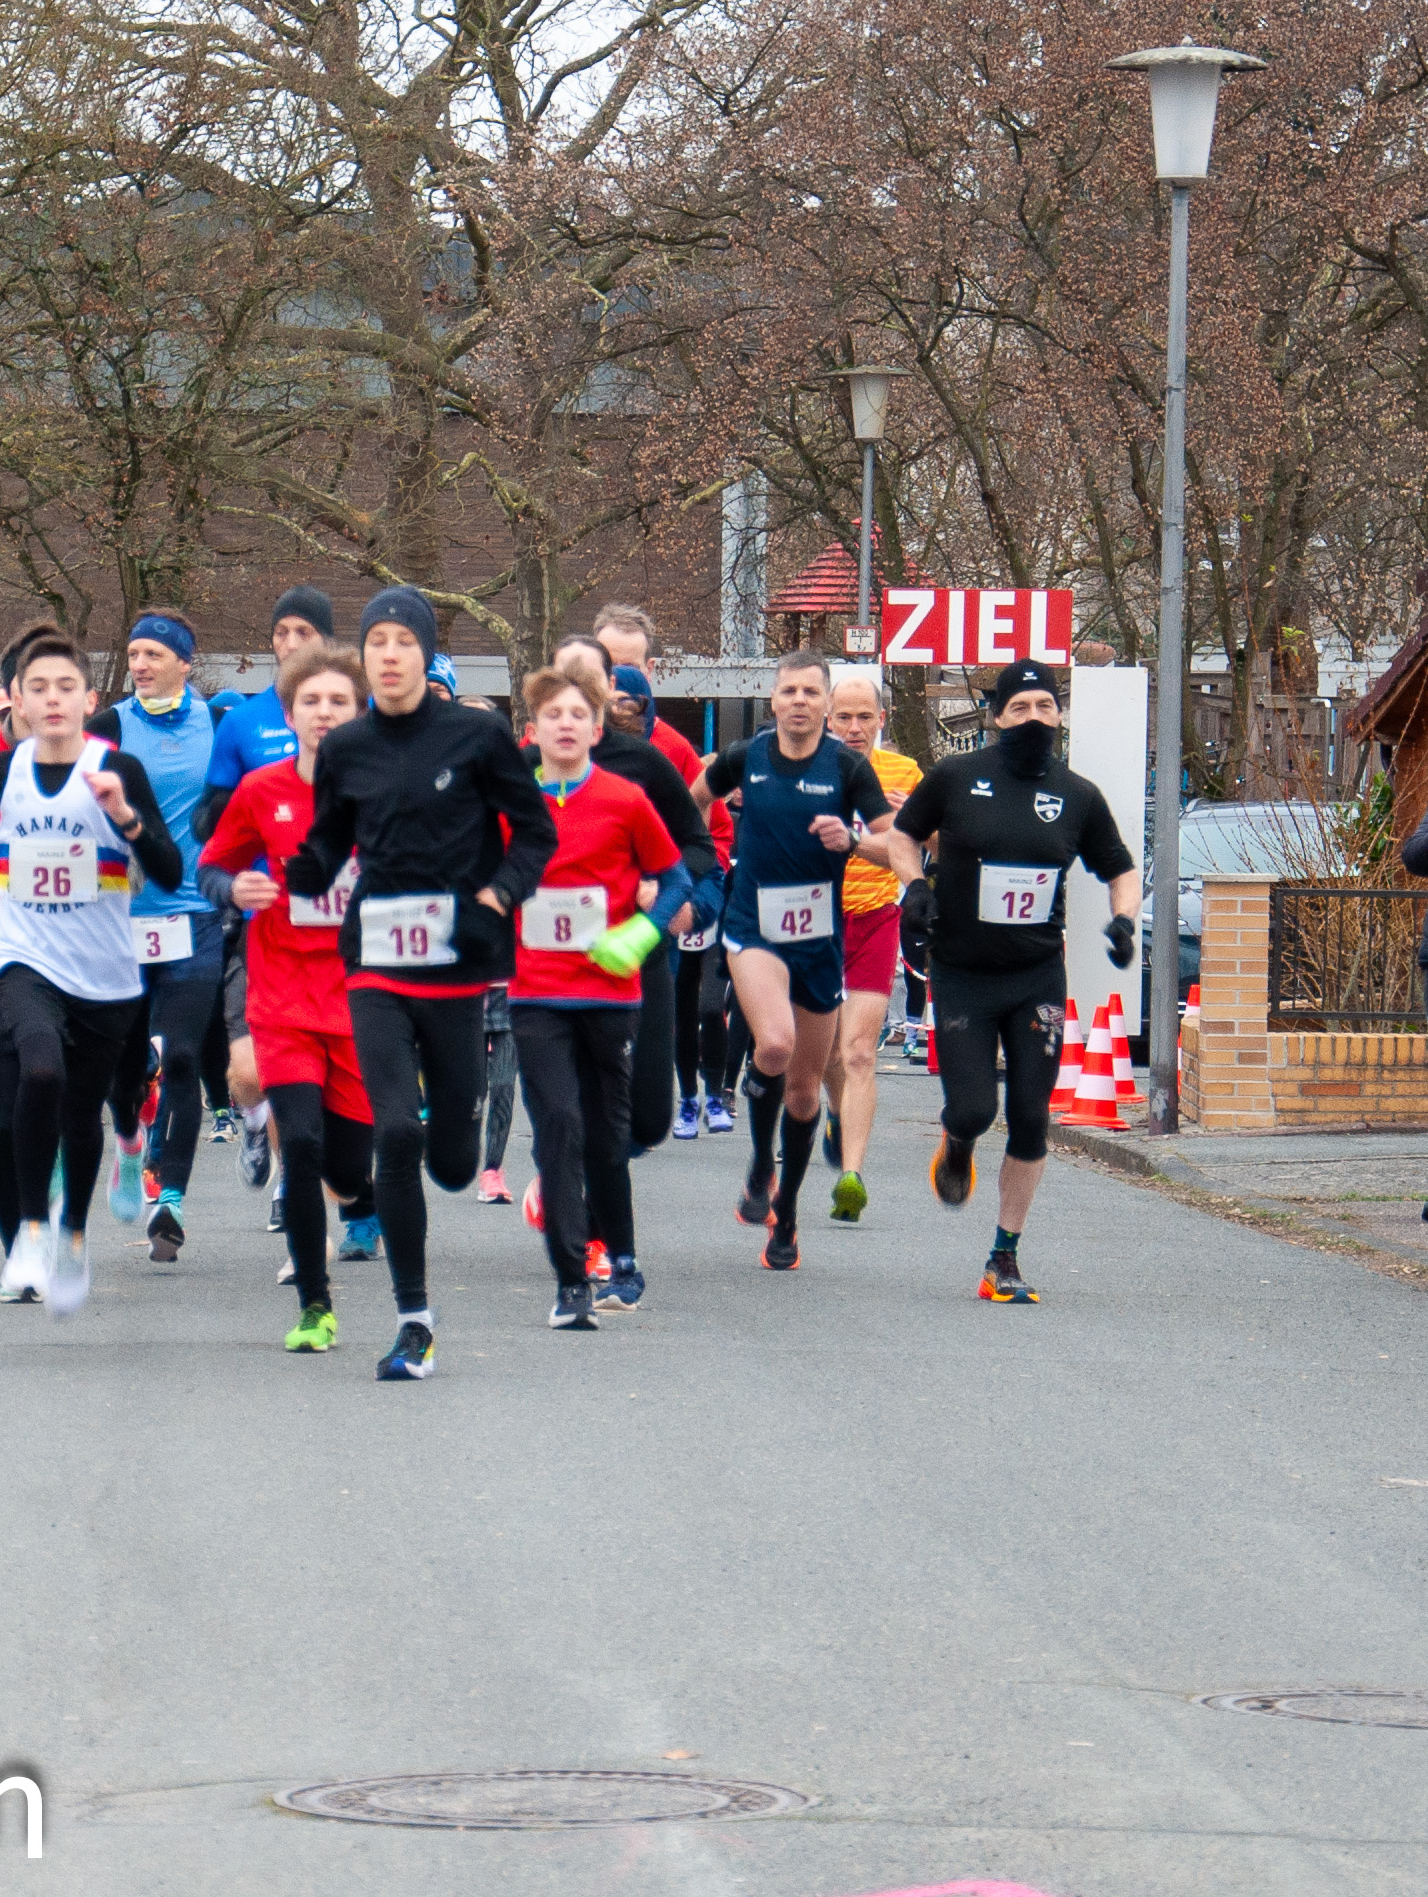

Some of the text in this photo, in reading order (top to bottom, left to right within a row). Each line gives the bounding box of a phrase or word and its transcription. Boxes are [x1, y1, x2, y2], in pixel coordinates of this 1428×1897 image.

[886, 590, 1067, 664] ZIEL
[15, 815, 84, 837] HANAU
[33, 866, 71, 897] 26
[1001, 891, 1035, 919] 12
[554, 914, 572, 943] 8
[780, 908, 812, 936] 42
[145, 931, 161, 957] 3
[390, 924, 428, 958] 19
[683, 931, 704, 947] 23
